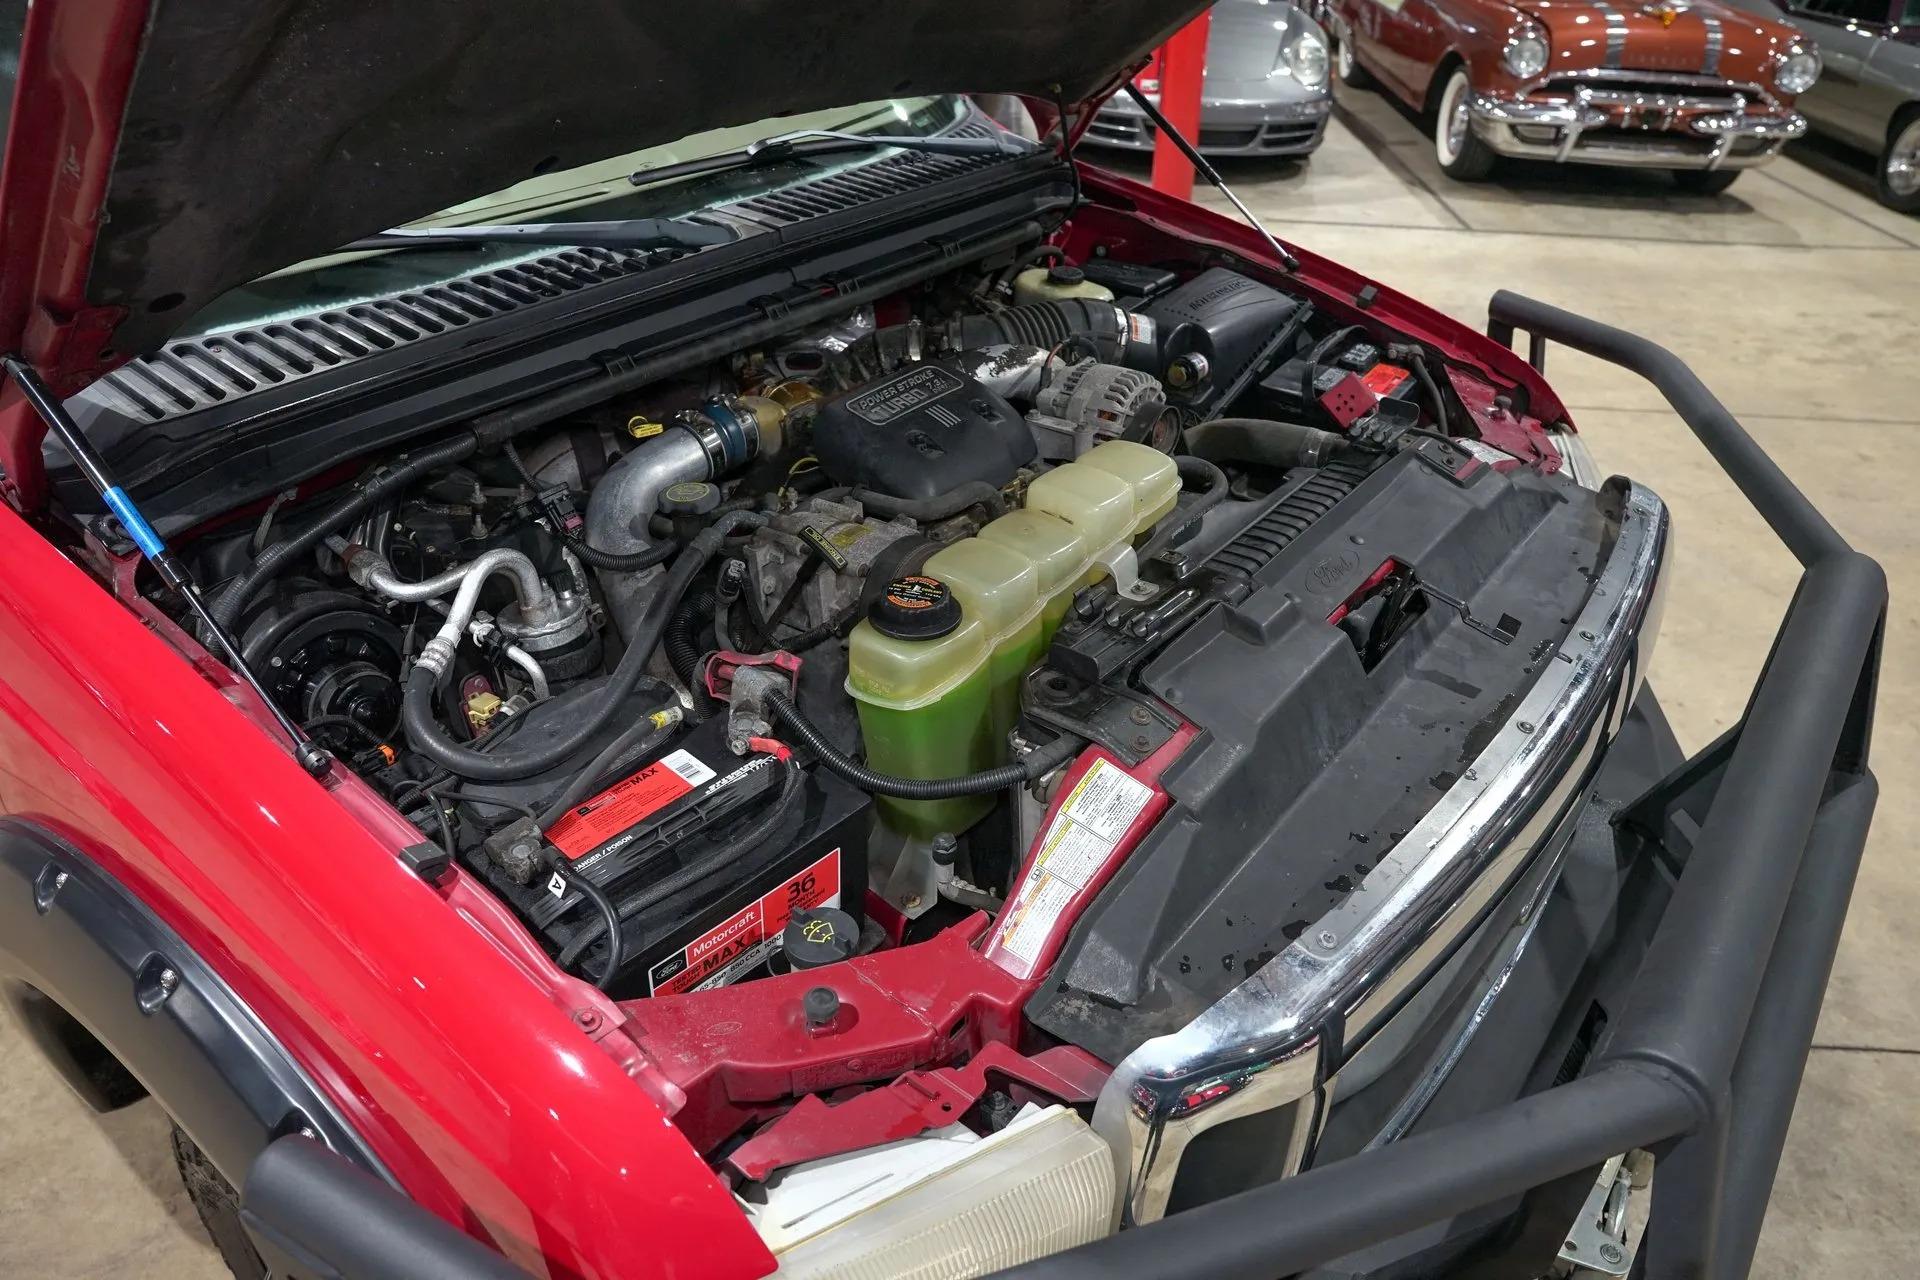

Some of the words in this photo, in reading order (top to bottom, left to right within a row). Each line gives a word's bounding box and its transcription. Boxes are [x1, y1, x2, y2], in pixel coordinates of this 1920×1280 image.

[859, 386, 898, 410] POWER
[896, 369, 935, 392] STROKE
[870, 388, 929, 420] TURBO
[630, 767, 659, 786] MAX
[551, 876, 562, 890] A
[786, 872, 816, 903] 36
[692, 910, 756, 958] Motorcraft
[702, 936, 746, 972] MAX
[745, 948, 761, 961] CCA
